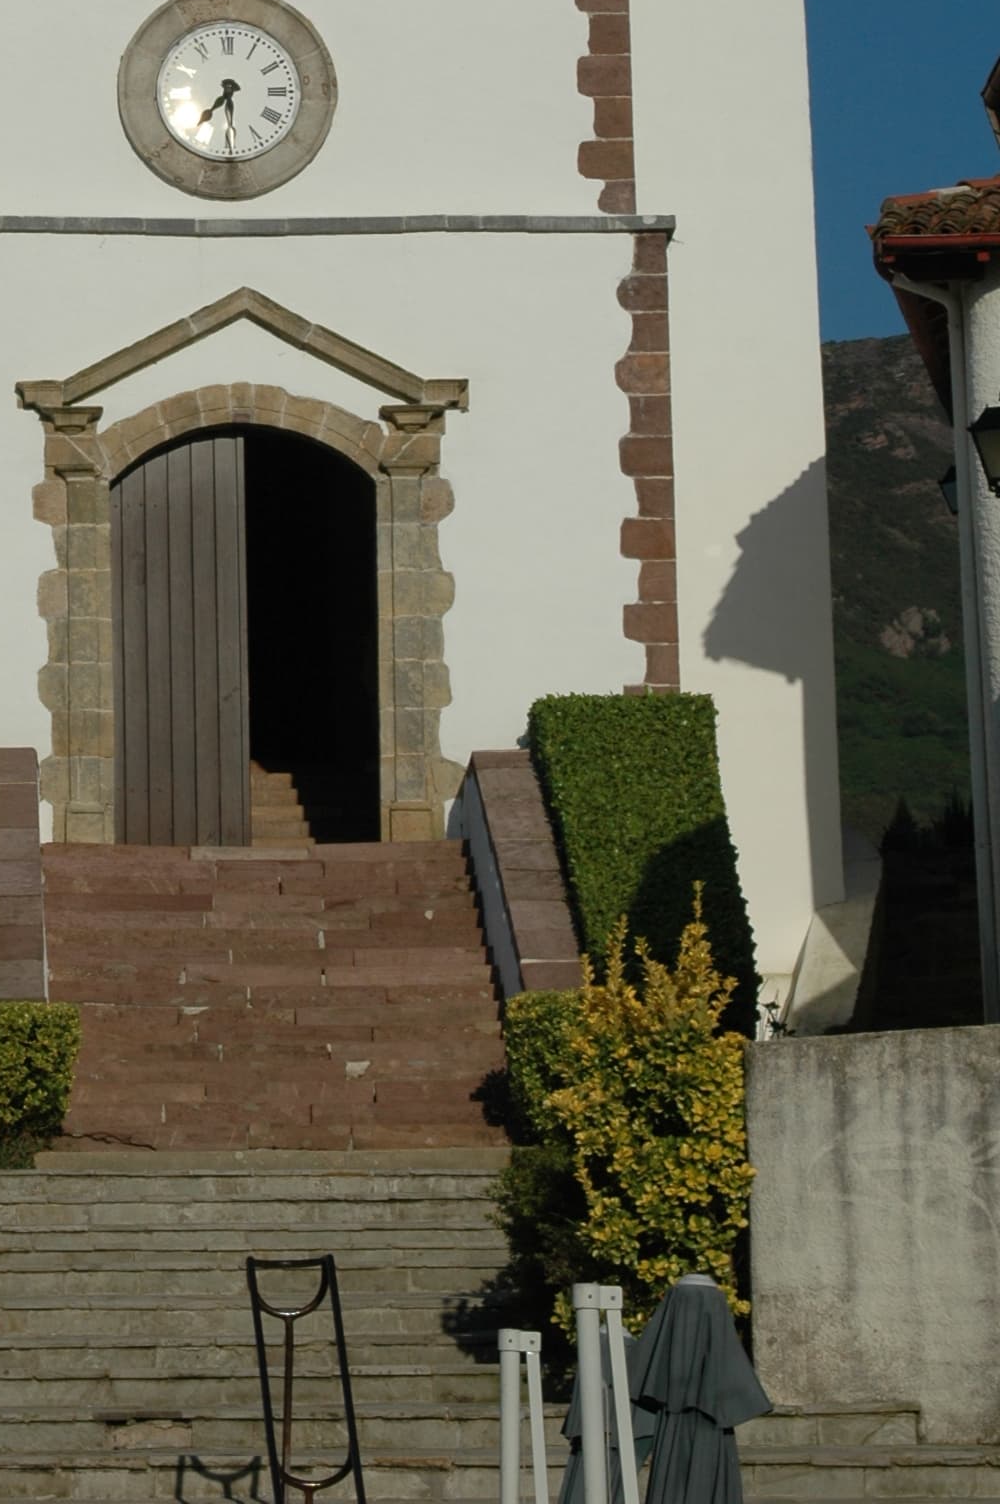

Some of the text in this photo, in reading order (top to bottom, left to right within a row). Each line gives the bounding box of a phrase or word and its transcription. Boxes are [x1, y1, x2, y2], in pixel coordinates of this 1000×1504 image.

[219, 36, 234, 55] XII
[246, 43, 257, 60] I
[260, 61, 279, 75] II
[267, 87, 287, 96] III
